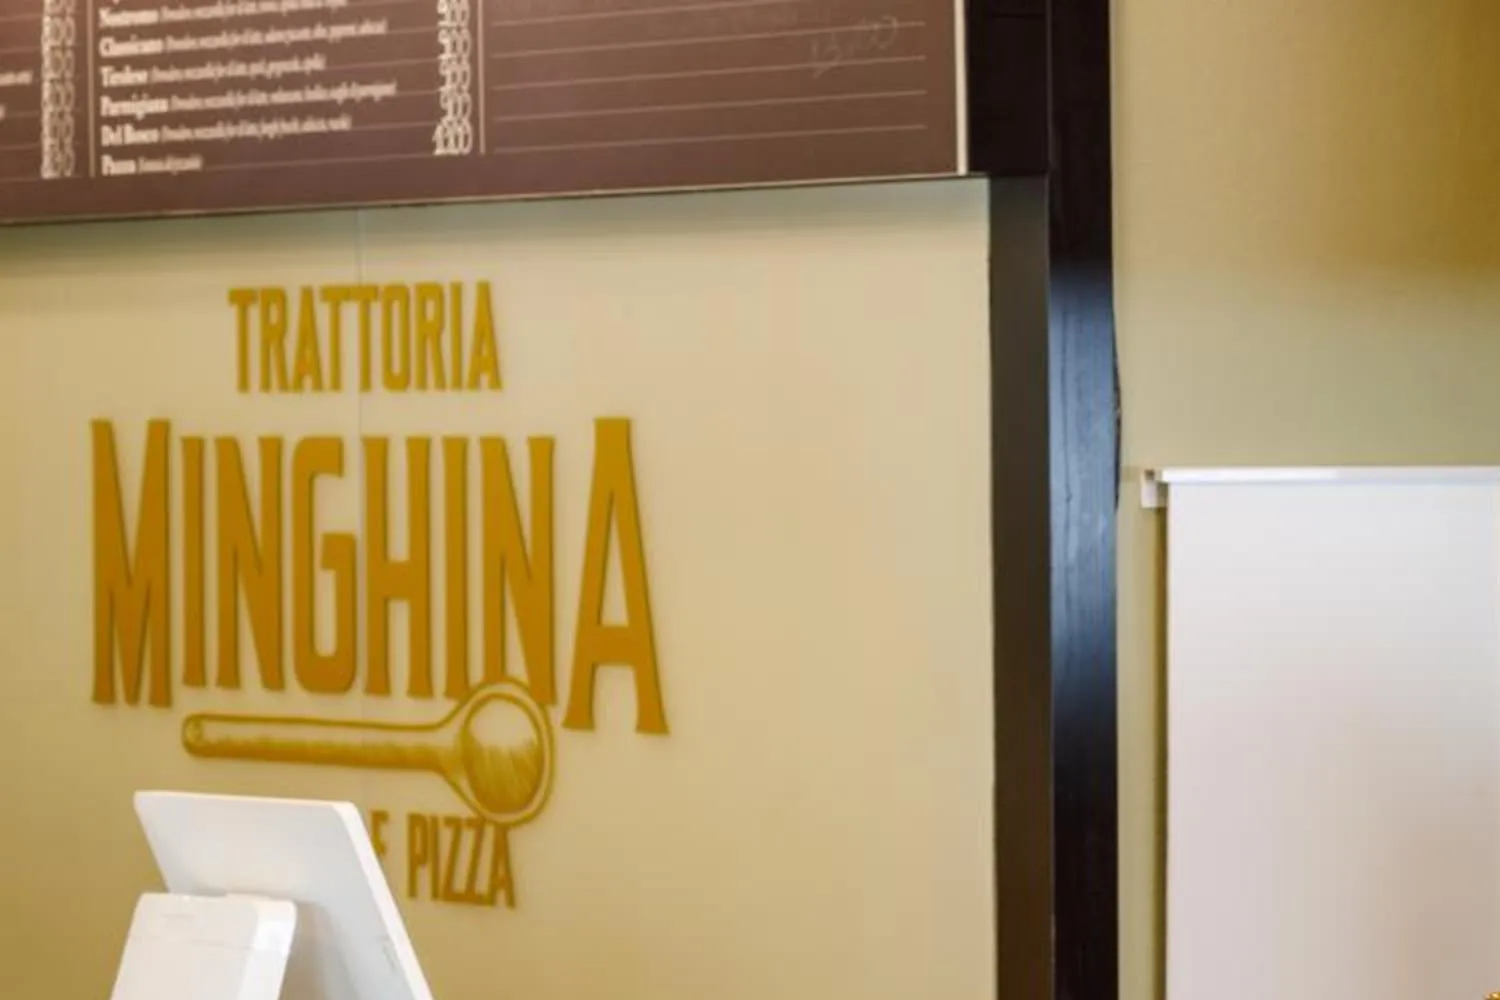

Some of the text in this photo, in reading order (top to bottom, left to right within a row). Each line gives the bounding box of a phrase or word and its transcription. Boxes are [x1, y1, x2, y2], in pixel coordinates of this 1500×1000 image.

[228, 281, 504, 394] TRATTORIA
[90, 416, 670, 736] MINGHINA
[407, 812, 516, 909] PIZZA
